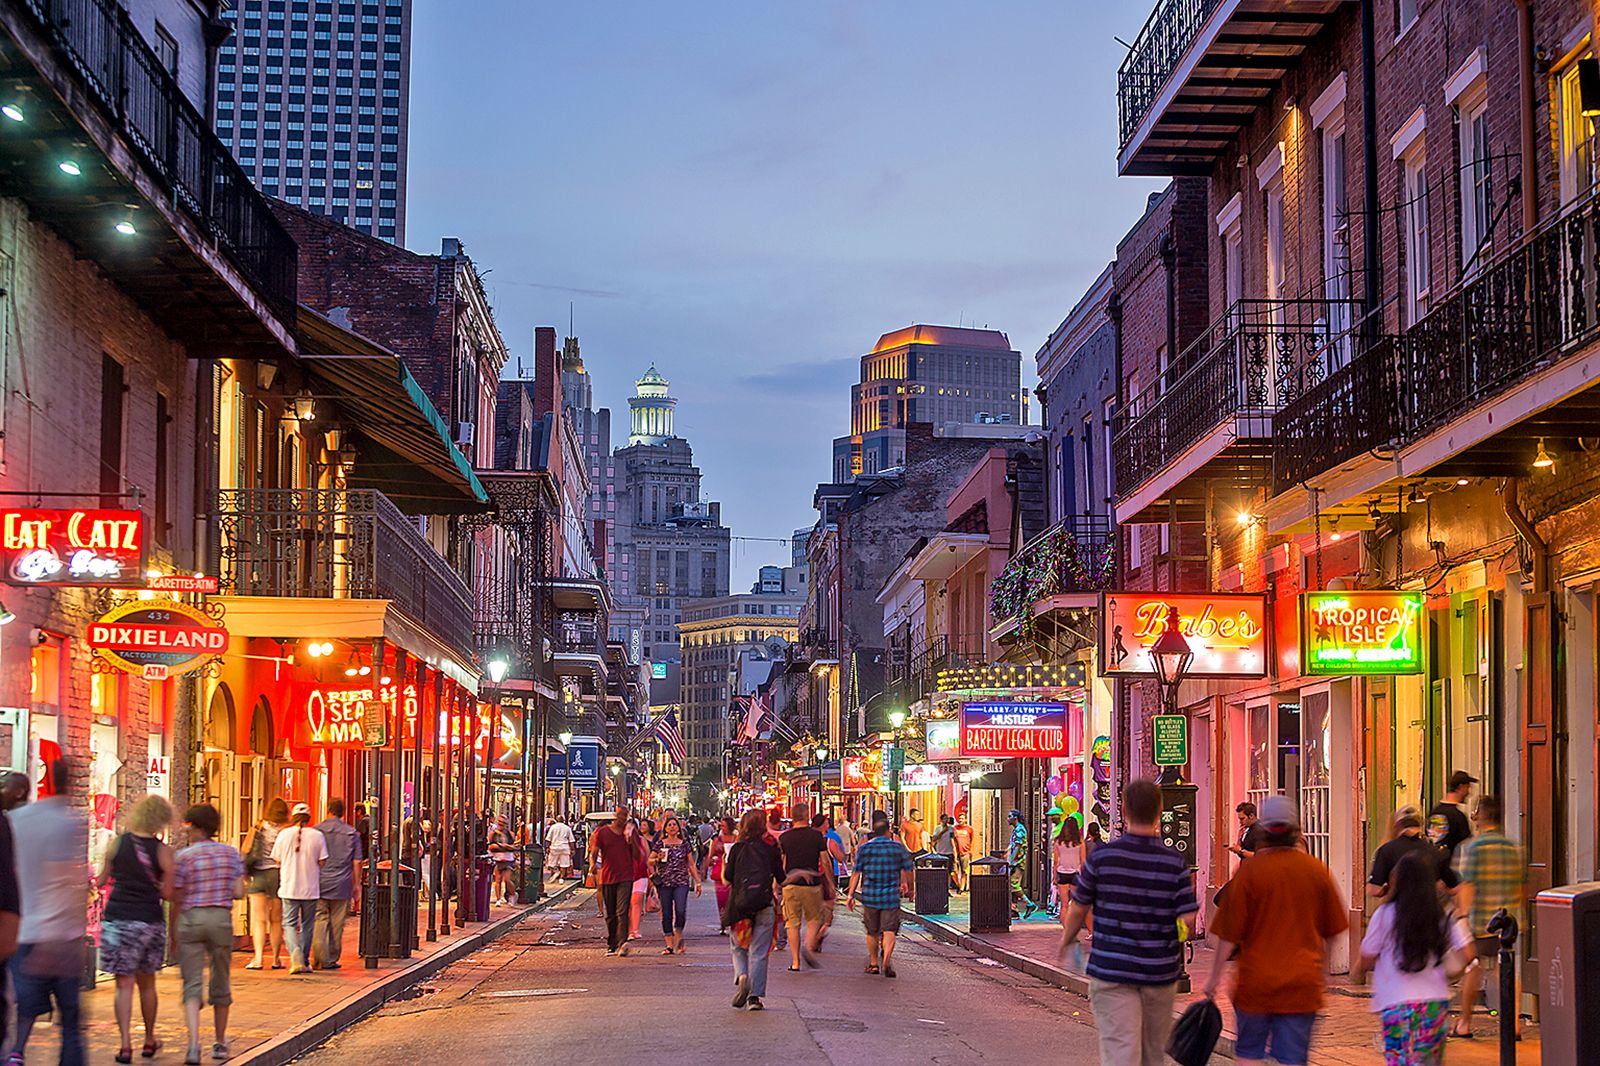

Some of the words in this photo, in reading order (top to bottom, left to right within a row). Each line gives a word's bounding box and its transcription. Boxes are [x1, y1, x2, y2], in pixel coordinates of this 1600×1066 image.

[147, 612, 171, 620] 434
[1133, 601, 1263, 639] Babe's
[93, 627, 225, 649] DIXIELAND
[1343, 625, 1387, 642] ISLE
[119, 651, 156, 659] FACTORY
[145, 667, 167, 677] ATM
[327, 689, 374, 703] PIER
[983, 706, 1009, 714] LARRY
[991, 714, 1035, 725] HUSTLER
[966, 729, 1004, 751] BARELY
[1006, 729, 1036, 751] LEGAL
[1039, 729, 1063, 751] CLUB
[940, 764, 962, 773] FRESH
[981, 763, 1002, 773] GRILL
